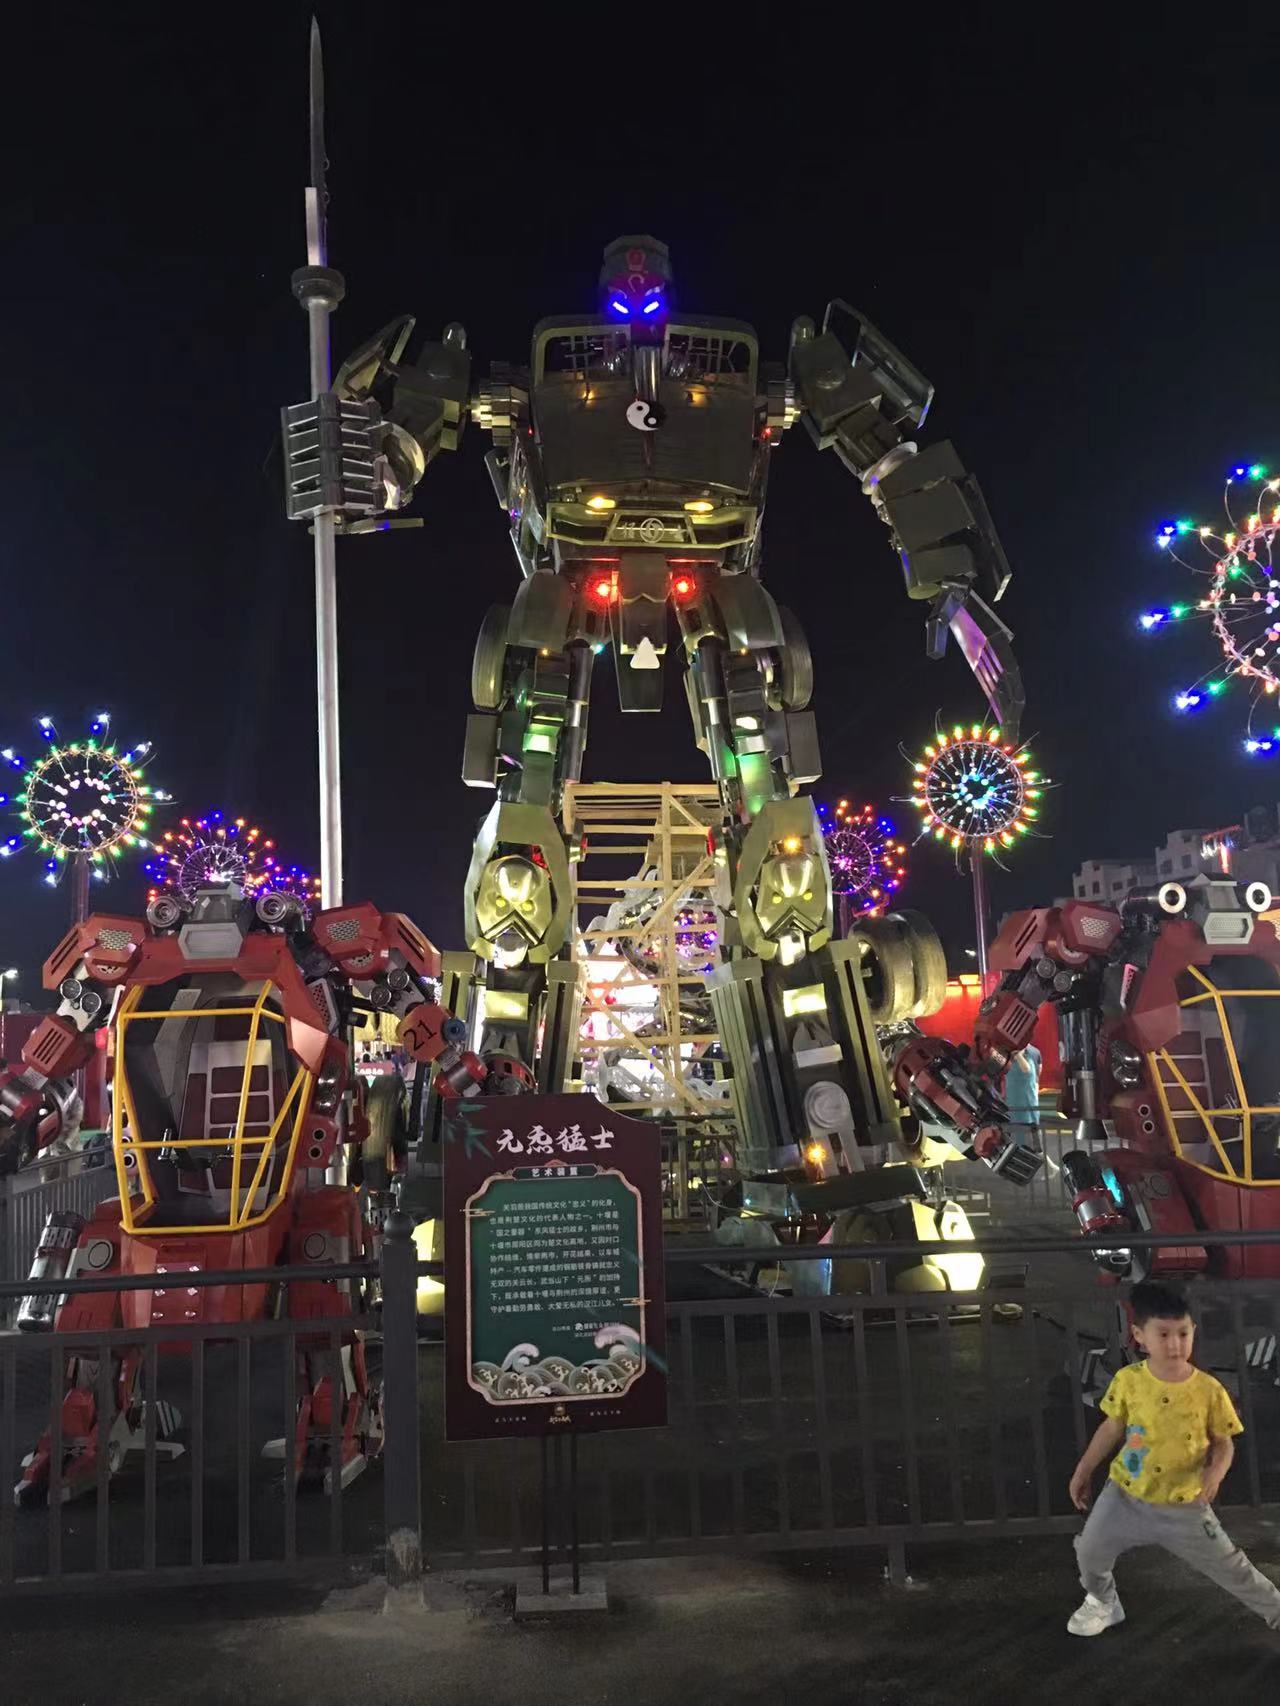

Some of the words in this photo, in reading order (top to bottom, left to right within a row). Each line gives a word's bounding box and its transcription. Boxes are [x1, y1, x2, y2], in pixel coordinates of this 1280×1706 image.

[403, 1020, 438, 1051] 21
[531, 1166, 579, 1178] 艺术装置
